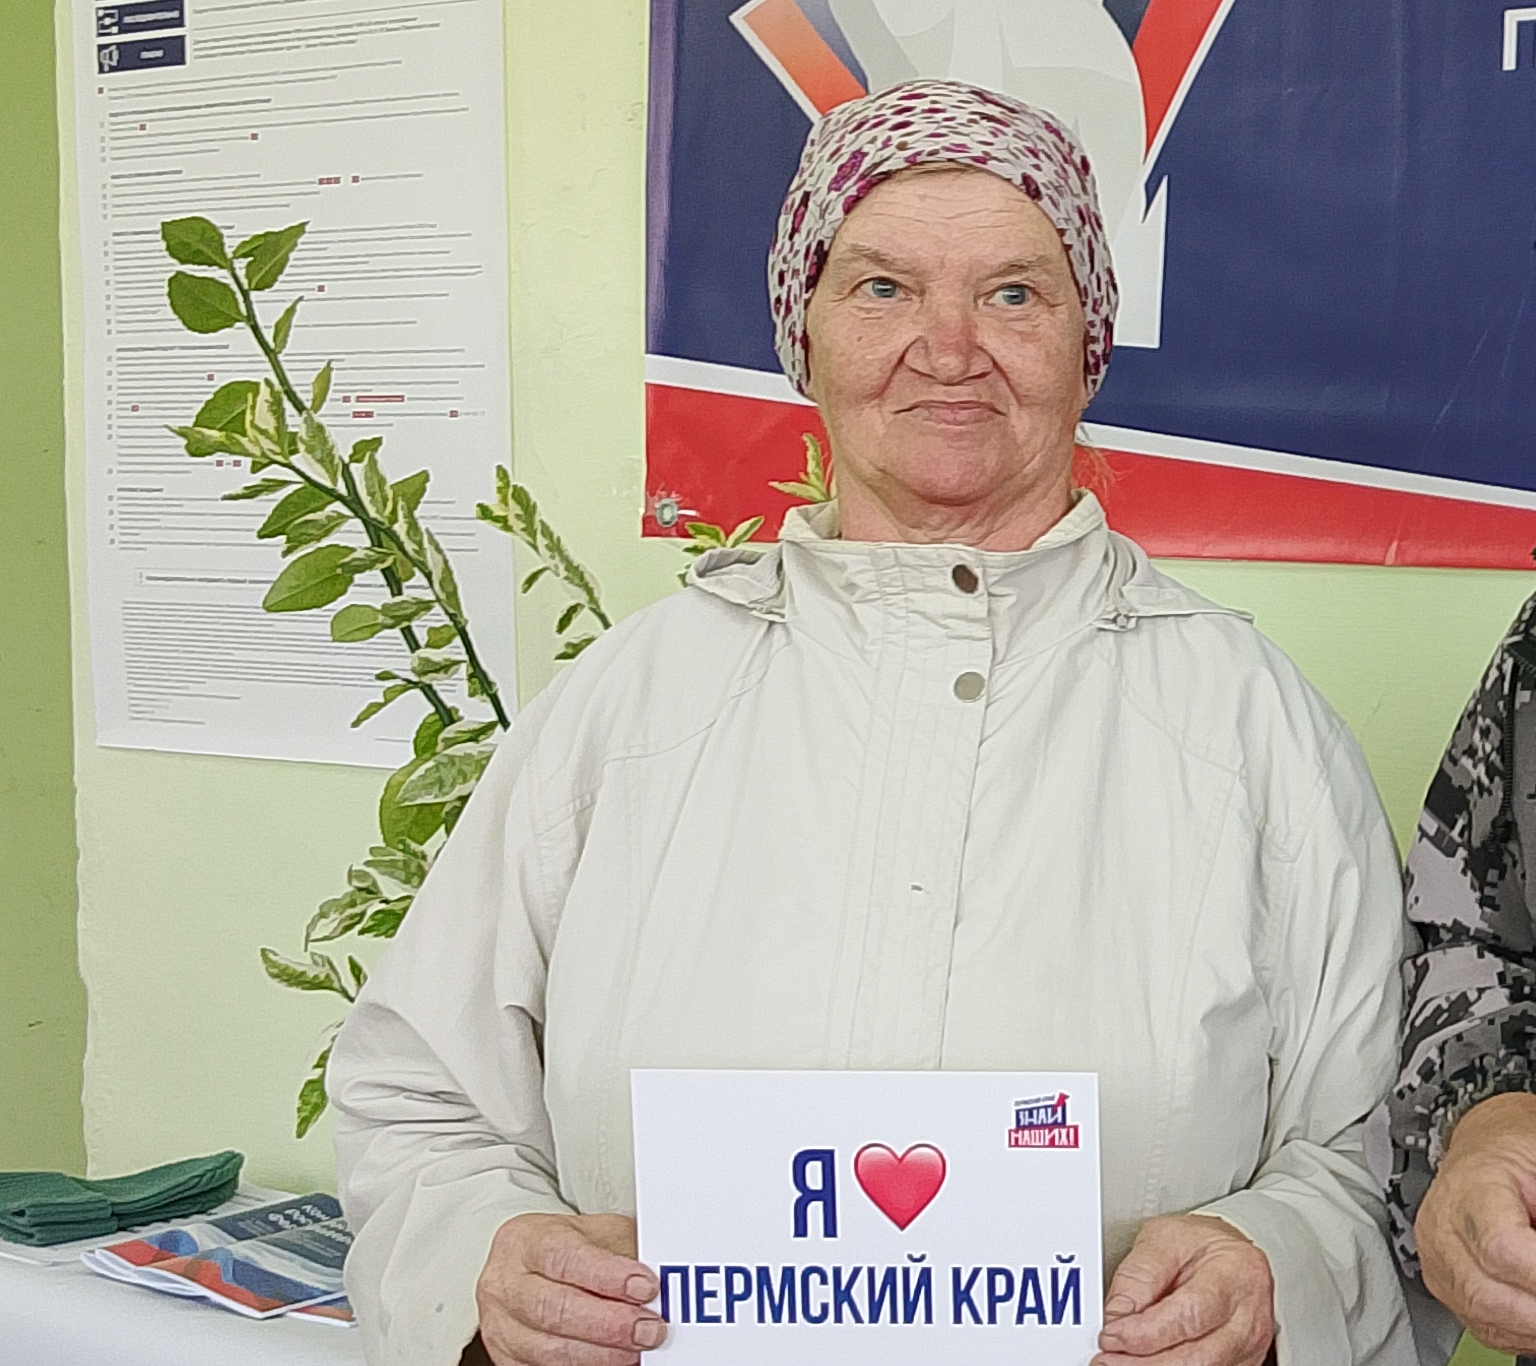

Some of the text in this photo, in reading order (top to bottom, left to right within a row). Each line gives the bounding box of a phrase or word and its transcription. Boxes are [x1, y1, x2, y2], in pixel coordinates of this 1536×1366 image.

[792, 1148, 838, 1238] Я
[659, 1253, 1082, 1326] ПЕРМСКИЙ КРАЙ
